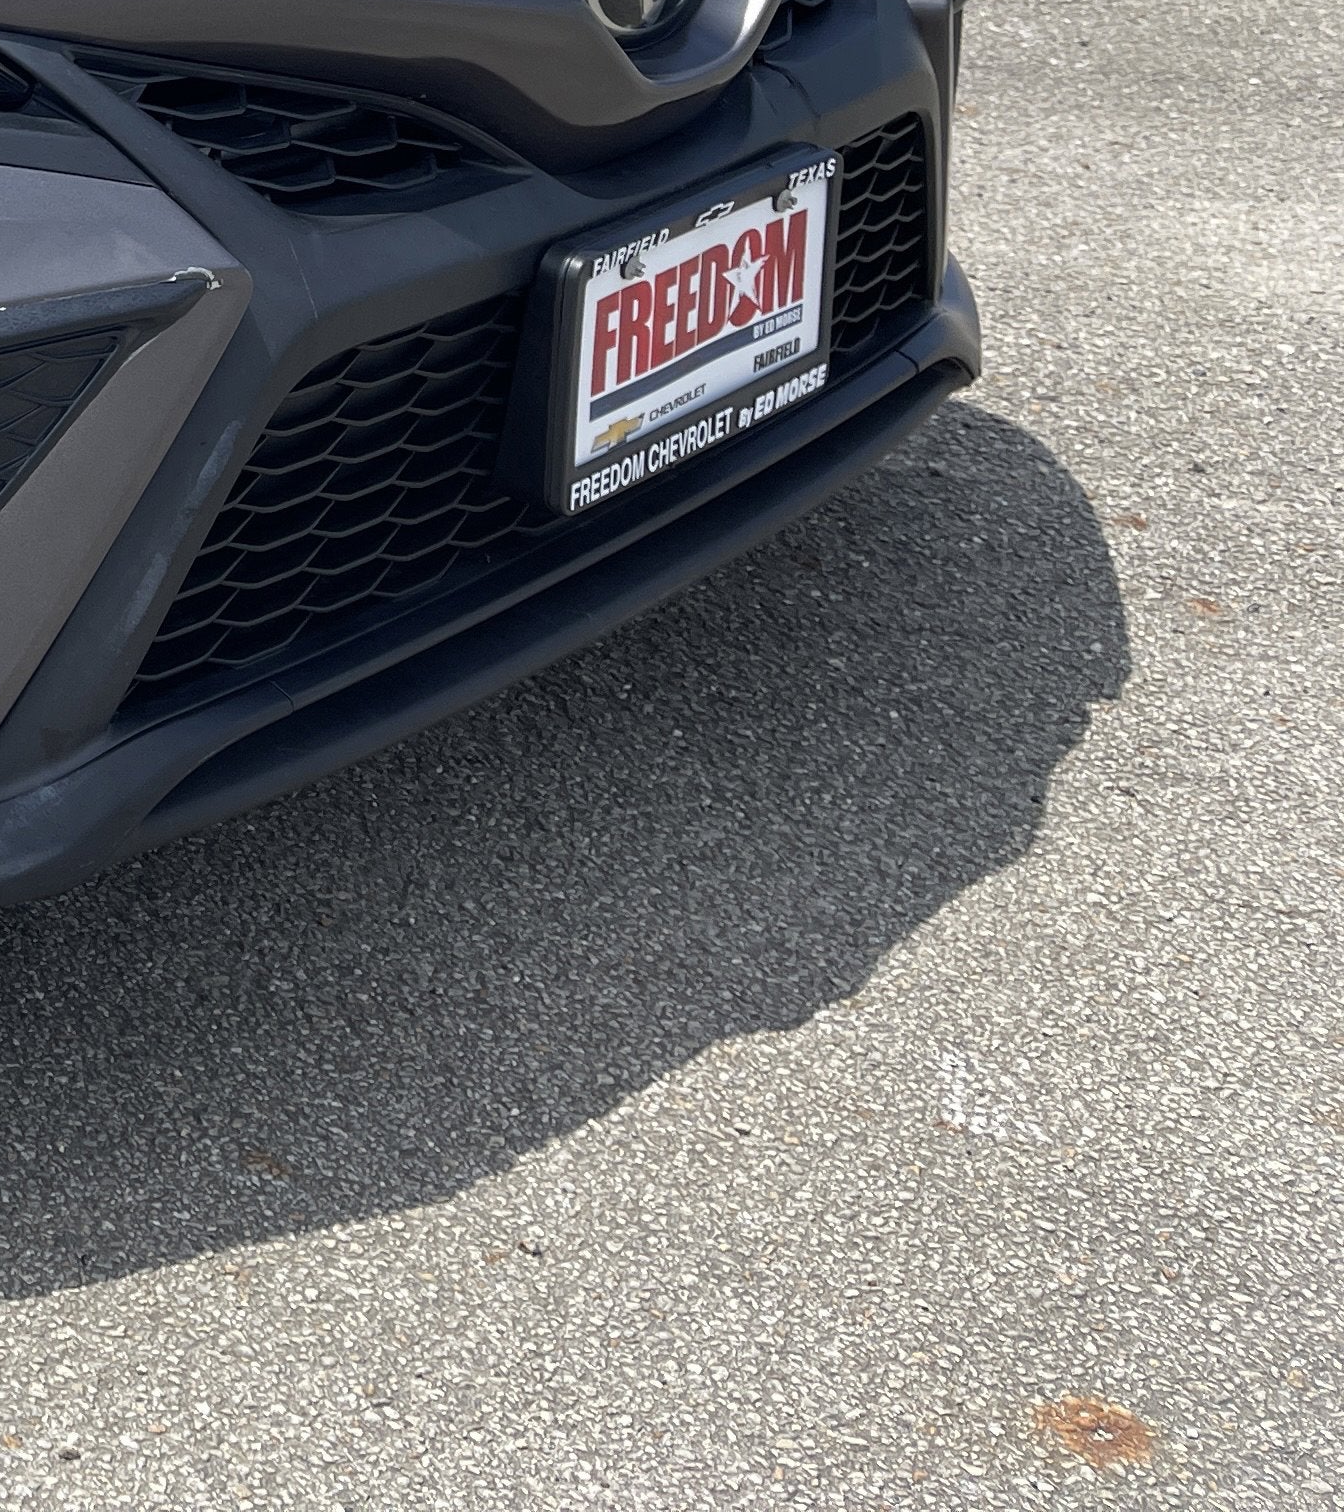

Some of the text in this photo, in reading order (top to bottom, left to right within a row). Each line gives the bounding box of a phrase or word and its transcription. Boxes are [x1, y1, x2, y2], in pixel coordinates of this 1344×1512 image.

[788, 158, 836, 190] TEXAS
[593, 227, 670, 278] FAIRFIELD
[591, 209, 808, 397] FREEDOM
[649, 383, 707, 422] CHEVROLET
[570, 450, 645, 510] FREEDOM
[648, 407, 734, 473] CHEVROLET
[754, 390, 775, 420] ED
[775, 363, 827, 409] MORSE
